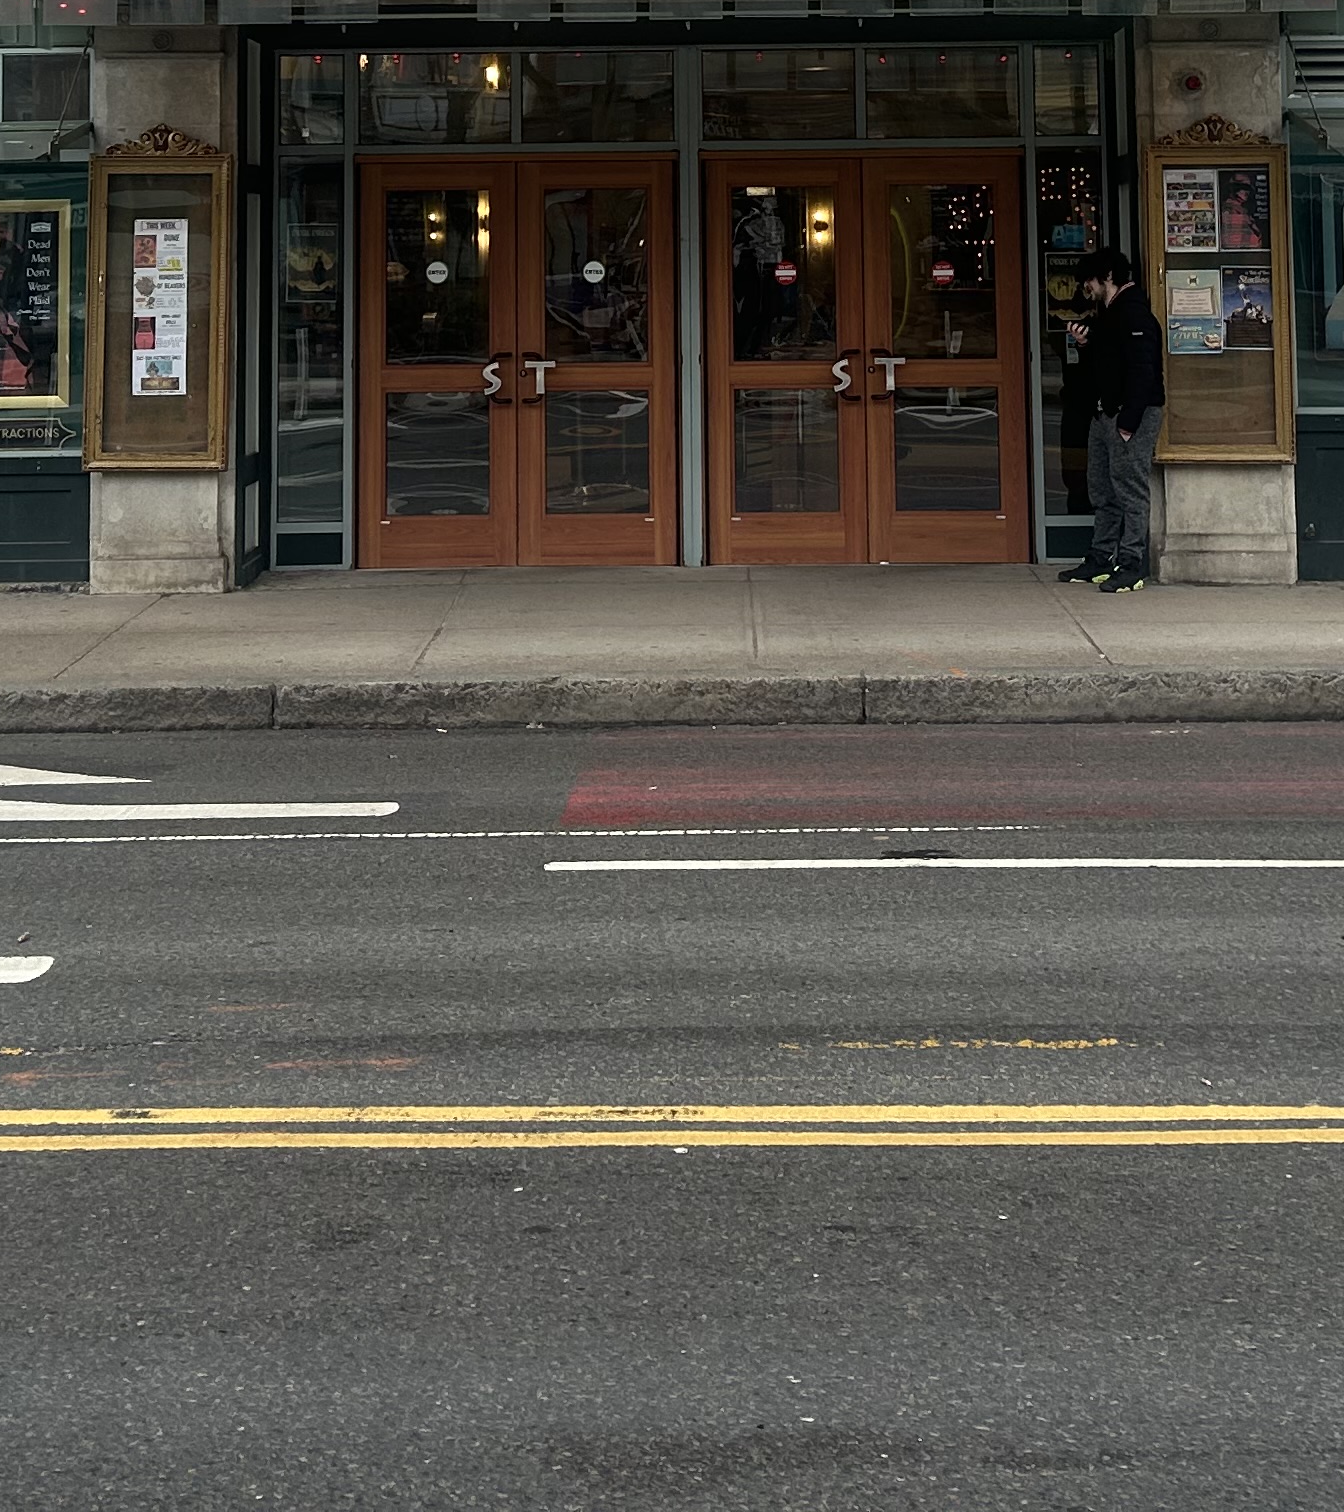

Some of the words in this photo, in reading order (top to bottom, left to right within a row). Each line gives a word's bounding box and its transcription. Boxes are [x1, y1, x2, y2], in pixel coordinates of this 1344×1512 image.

[28, 240, 51, 249] Dead
[31, 254, 51, 263] Men
[28, 282, 51, 291] Wear
